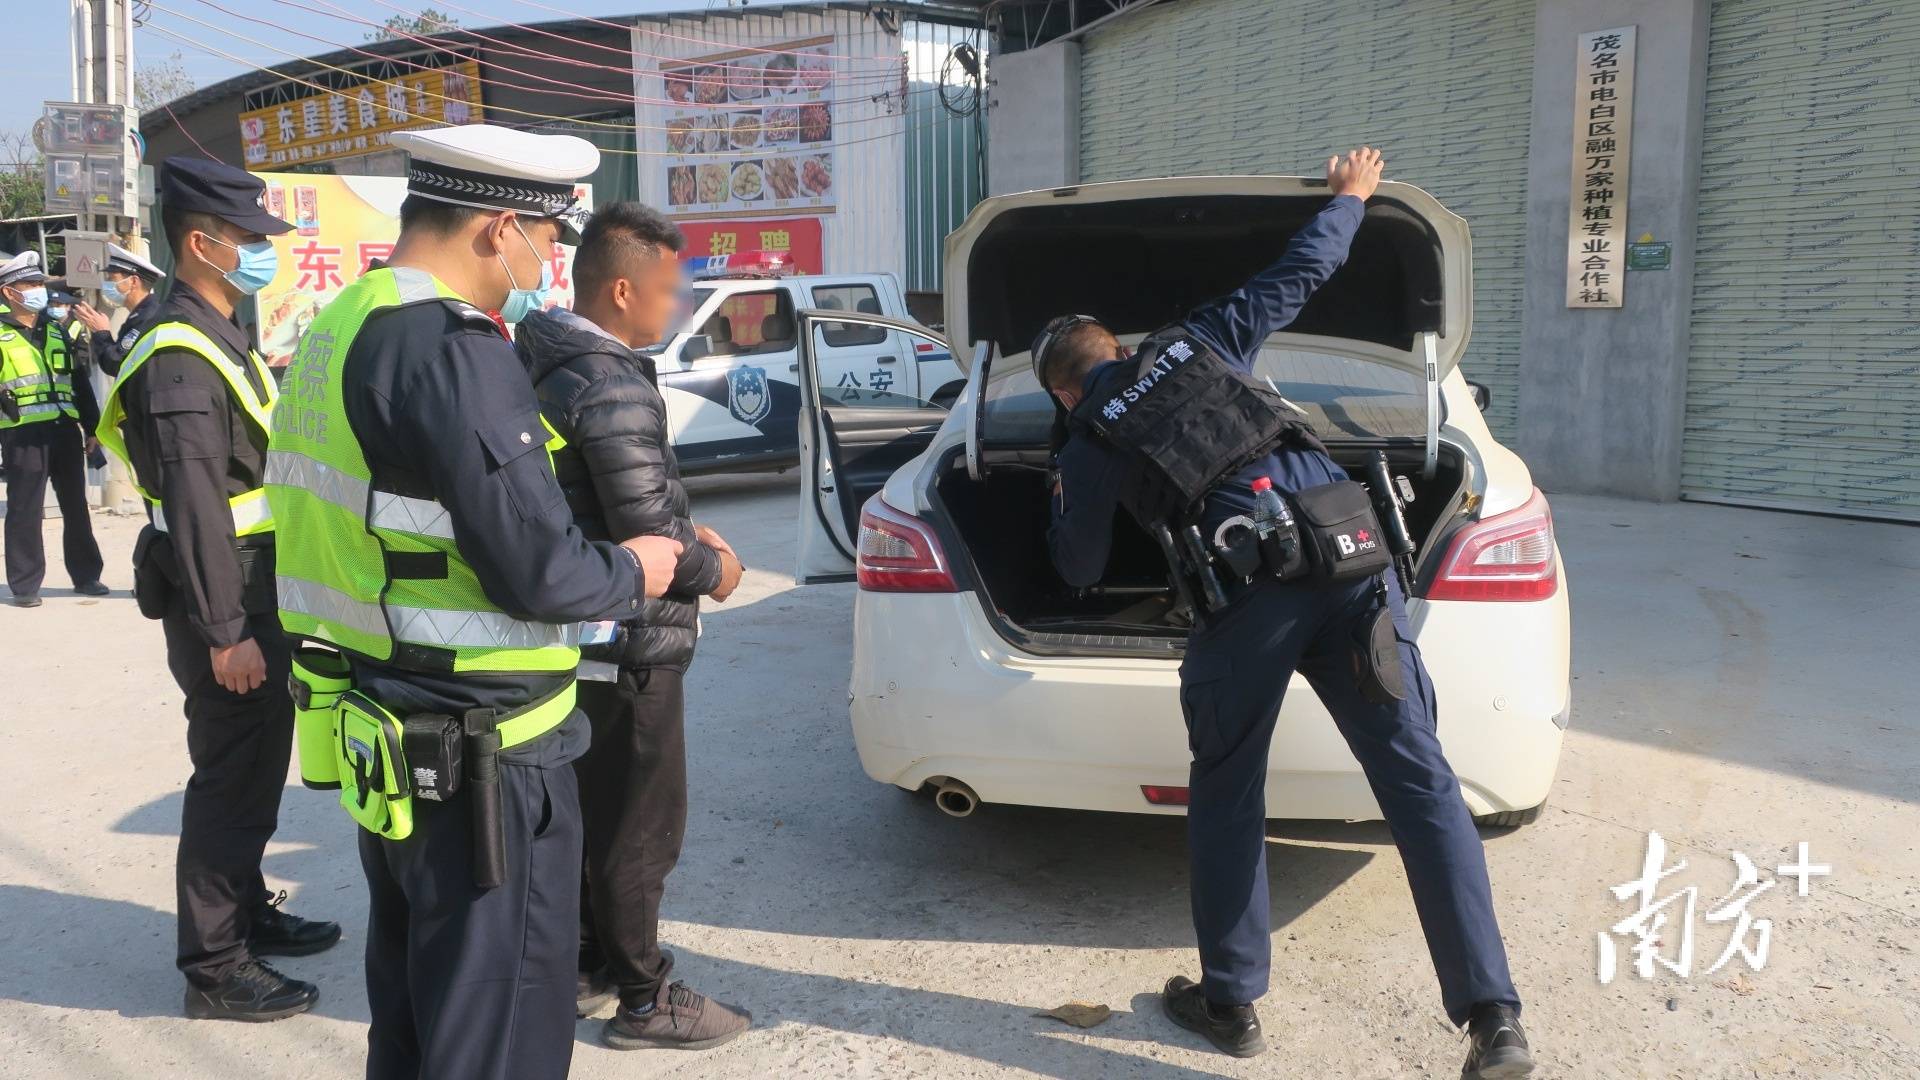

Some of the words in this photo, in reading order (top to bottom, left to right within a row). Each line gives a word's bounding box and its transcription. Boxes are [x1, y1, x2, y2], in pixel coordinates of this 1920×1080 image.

[277, 79, 408, 144] 东星美食城
[1579, 33, 1622, 304] 茂名市电白区融万家种植专业合作社
[836, 367, 894, 401] 公安
[272, 402, 328, 444] OLICE
[1337, 534, 1356, 555] B
[1358, 540, 1376, 551] POS
